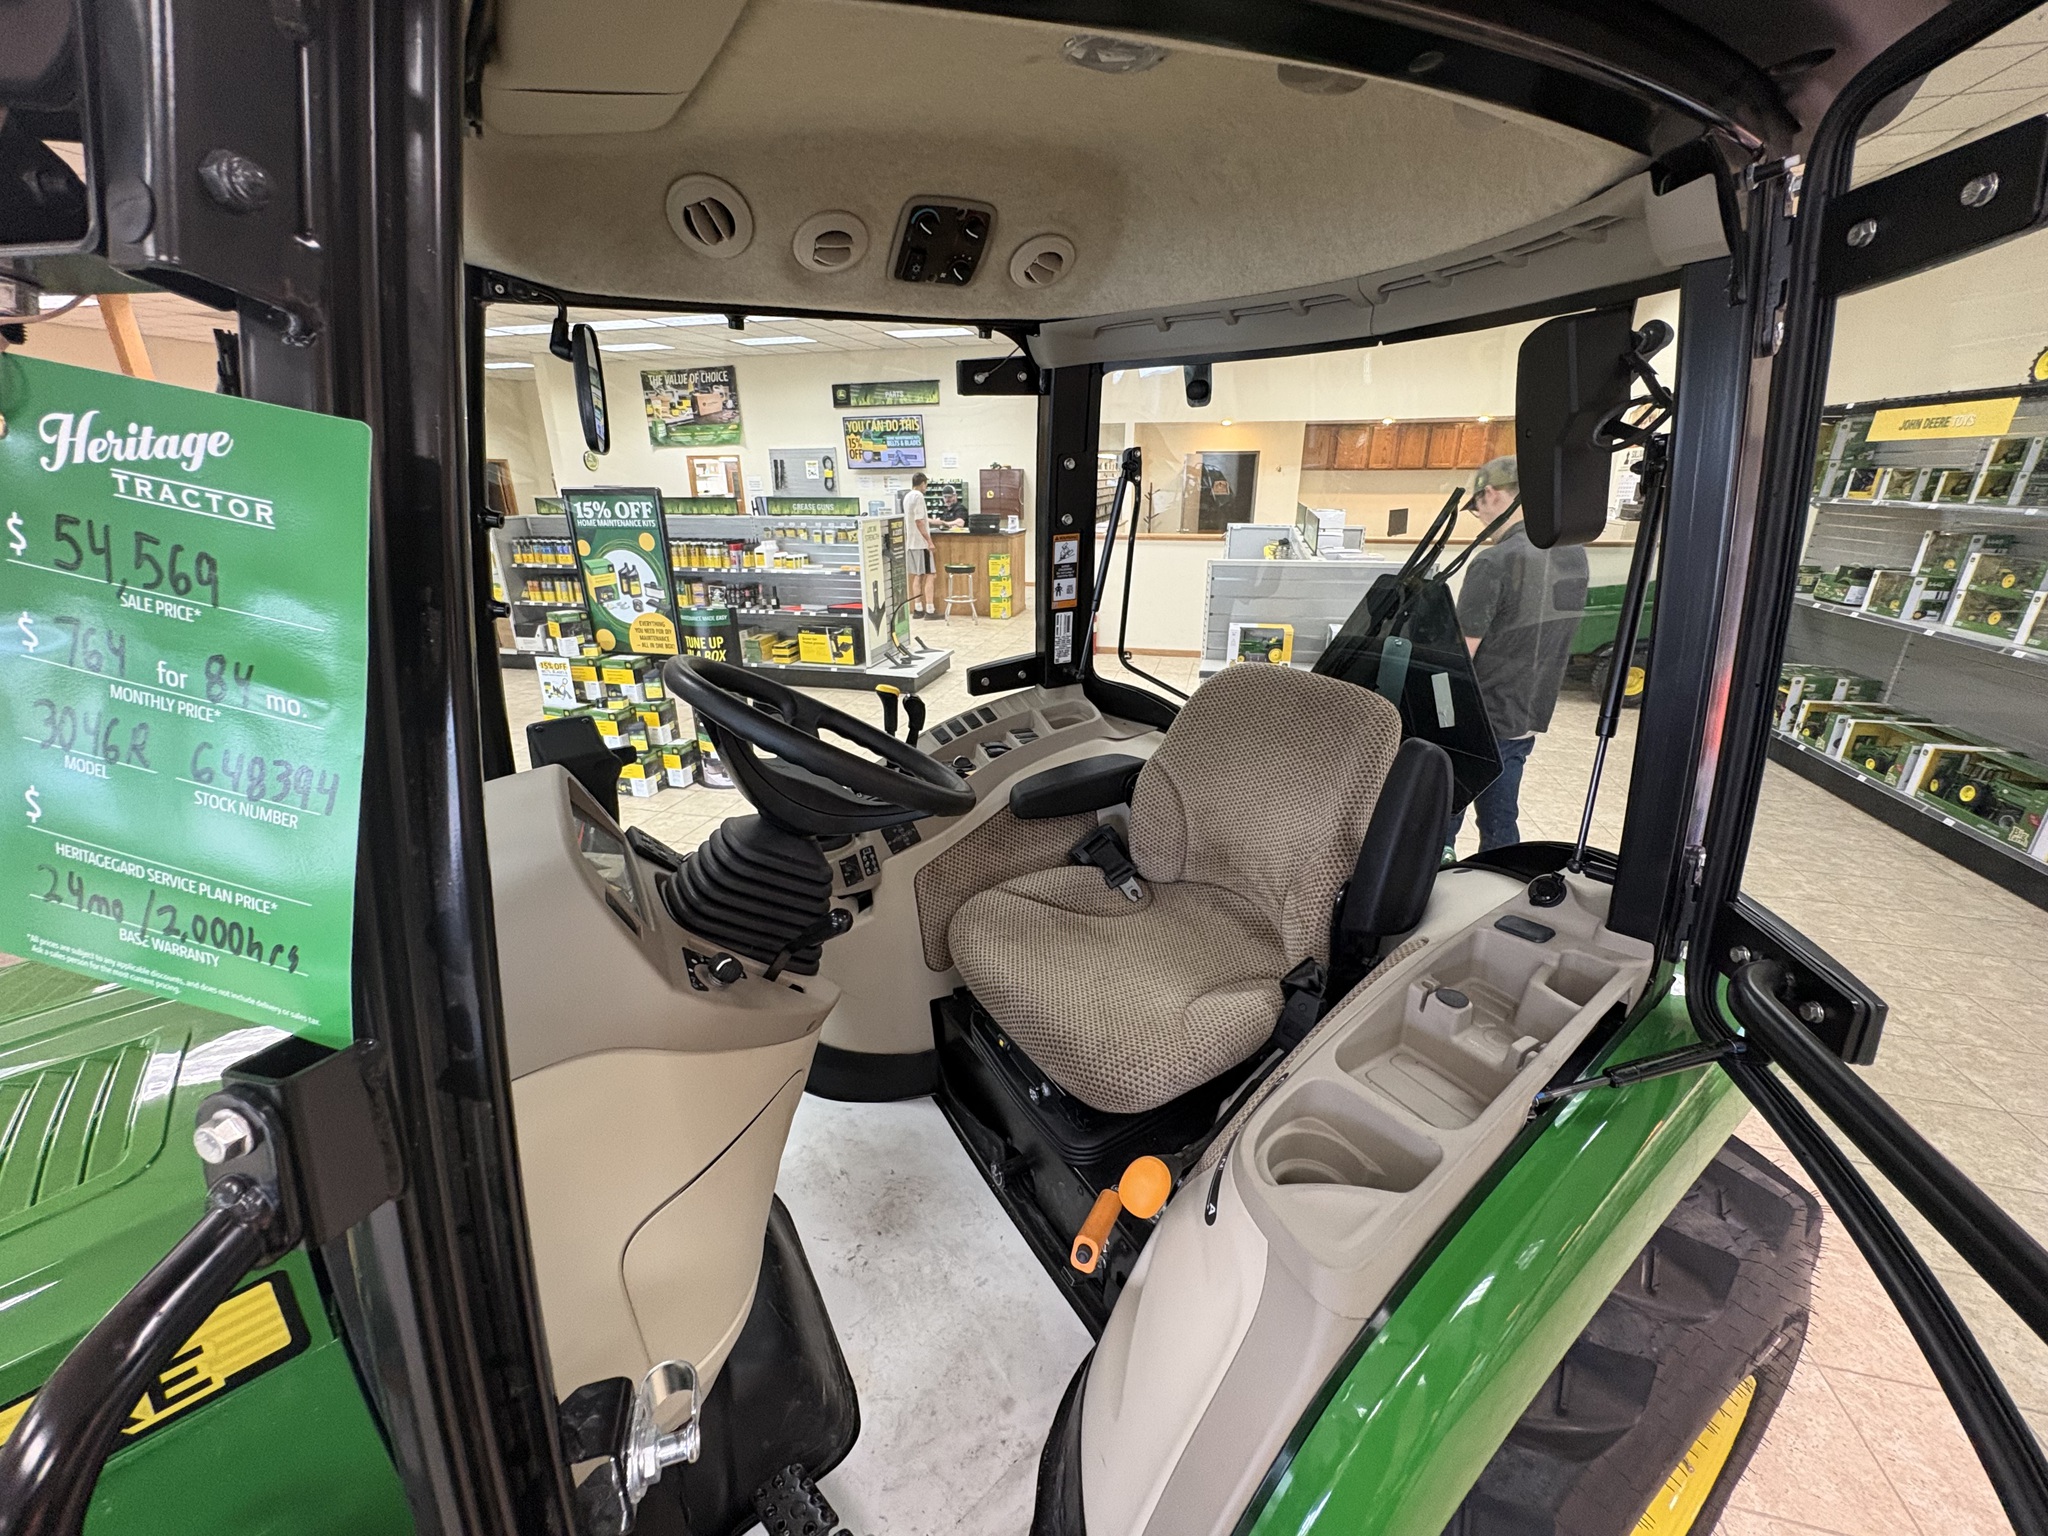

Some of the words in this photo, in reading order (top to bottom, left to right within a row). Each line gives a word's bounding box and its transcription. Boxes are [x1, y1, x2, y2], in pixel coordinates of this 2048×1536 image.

[648, 374, 663, 385] THE
[664, 373, 688, 385] VALUE
[689, 372, 699, 383] OF
[701, 371, 729, 383] CHOICE
[847, 421, 864, 433] YOU
[865, 420, 884, 432] CAN
[885, 420, 899, 432] DO
[900, 419, 920, 431] THIS
[1898, 419, 1923, 430] JOHN
[1922, 416, 1952, 429] DEERE
[1952, 414, 1977, 428] TOYS
[38, 410, 234, 472] Heritage
[848, 437, 863, 449] 15%
[849, 449, 863, 460] OFF
[111, 472, 275, 525] TRACTOR
[792, 503, 816, 511] GREASE
[816, 503, 835, 511] GUNS
[573, 501, 612, 519] 15%
[614, 501, 653, 519] OFF
[577, 519, 597, 527] HOME
[597, 519, 642, 527] MAINTENANCE
[643, 519, 656, 527] KITS
[6, 511, 28, 556] $
[54, 513, 220, 609] 54,569
[119, 592, 155, 613] SALE
[685, 635, 706, 649] TUNE
[708, 636, 724, 649] UP
[17, 611, 39, 653] $
[53, 615, 127, 677] 764
[155, 660, 188, 690] for
[204, 654, 255, 708] 84
[265, 693, 309, 719] mo.
[704, 649, 727, 662] BOX
[110, 684, 175, 713] MONTHLY
[64, 755, 110, 779] MODEL
[190, 741, 340, 817] 648394
[24, 785, 42, 823] $
[193, 790, 236, 815] STOCK
[238, 802, 299, 830] NUMBER
[55, 841, 145, 880] HERITAGEGARD
[147, 868, 198, 894] SERVICE
[198, 882, 233, 905] PLAN
[151, 937, 220, 968] WARRANTY
